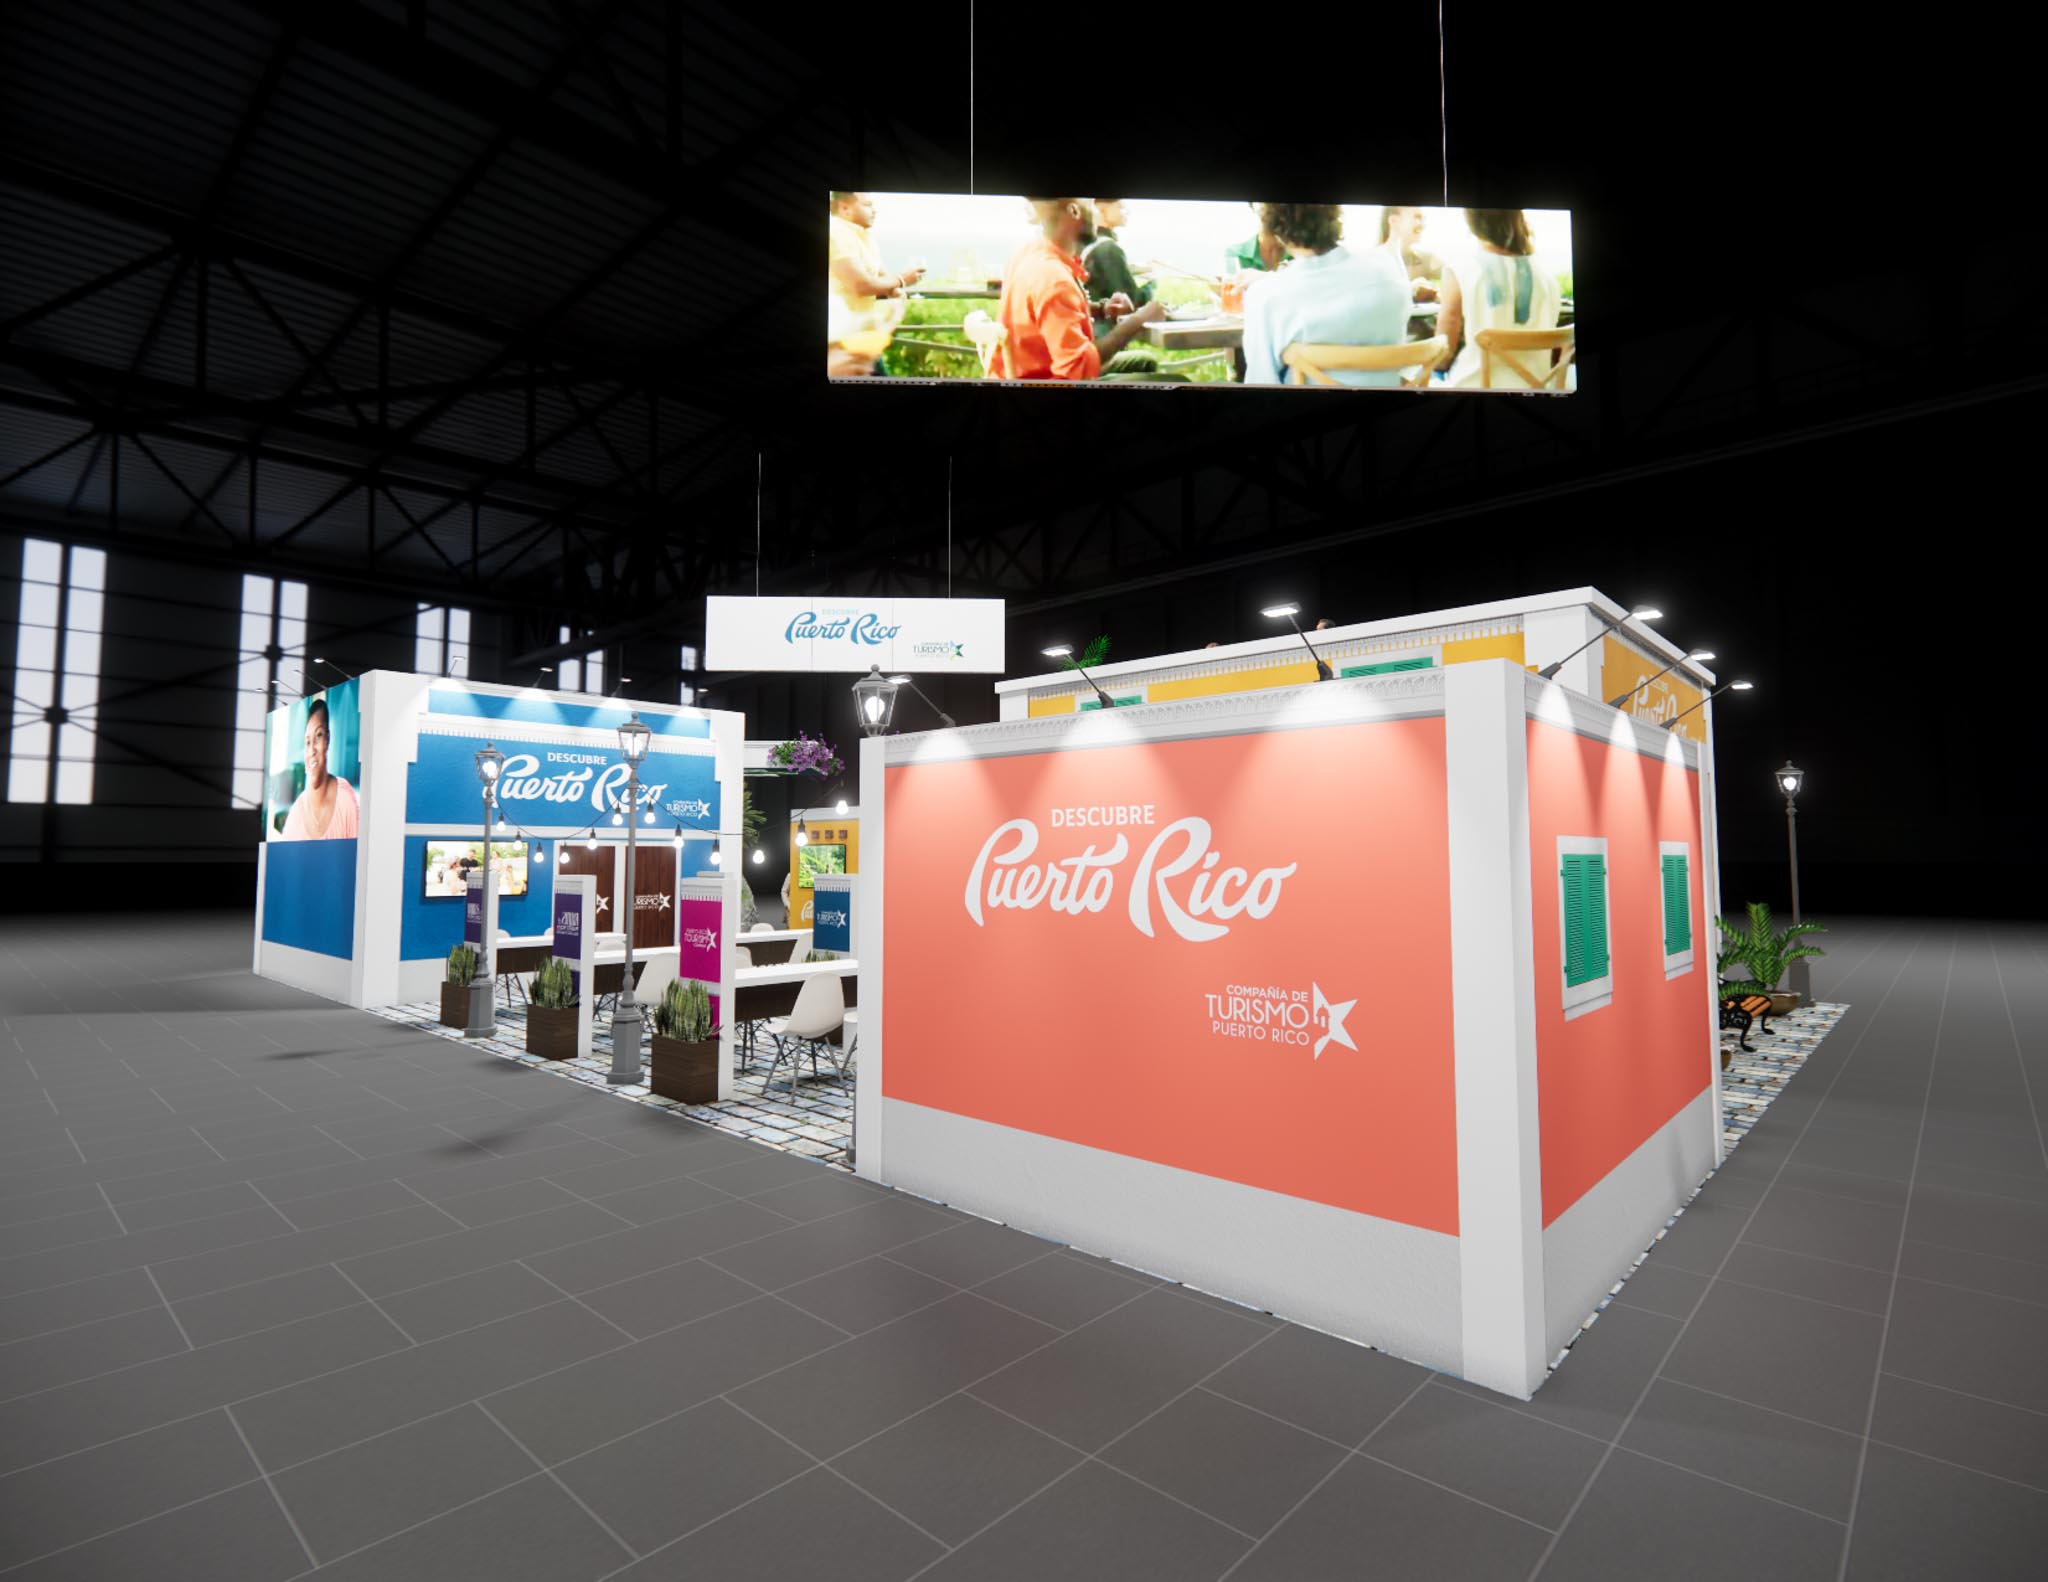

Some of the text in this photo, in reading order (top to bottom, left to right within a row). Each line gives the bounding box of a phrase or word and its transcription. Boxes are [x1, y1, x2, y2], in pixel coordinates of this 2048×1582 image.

[785, 611, 902, 645] Puerto Rico
[547, 752, 608, 765] DESCUBRE
[482, 754, 594, 808] Puerto
[1051, 805, 1155, 828] DESCUBRE
[965, 816, 1297, 942] Puerto Rico
[1226, 984, 1309, 1002] COMPAÑÍA DE
[1205, 994, 1309, 1029] TURISMO
[1213, 1020, 1310, 1046] PUERTO RICO
